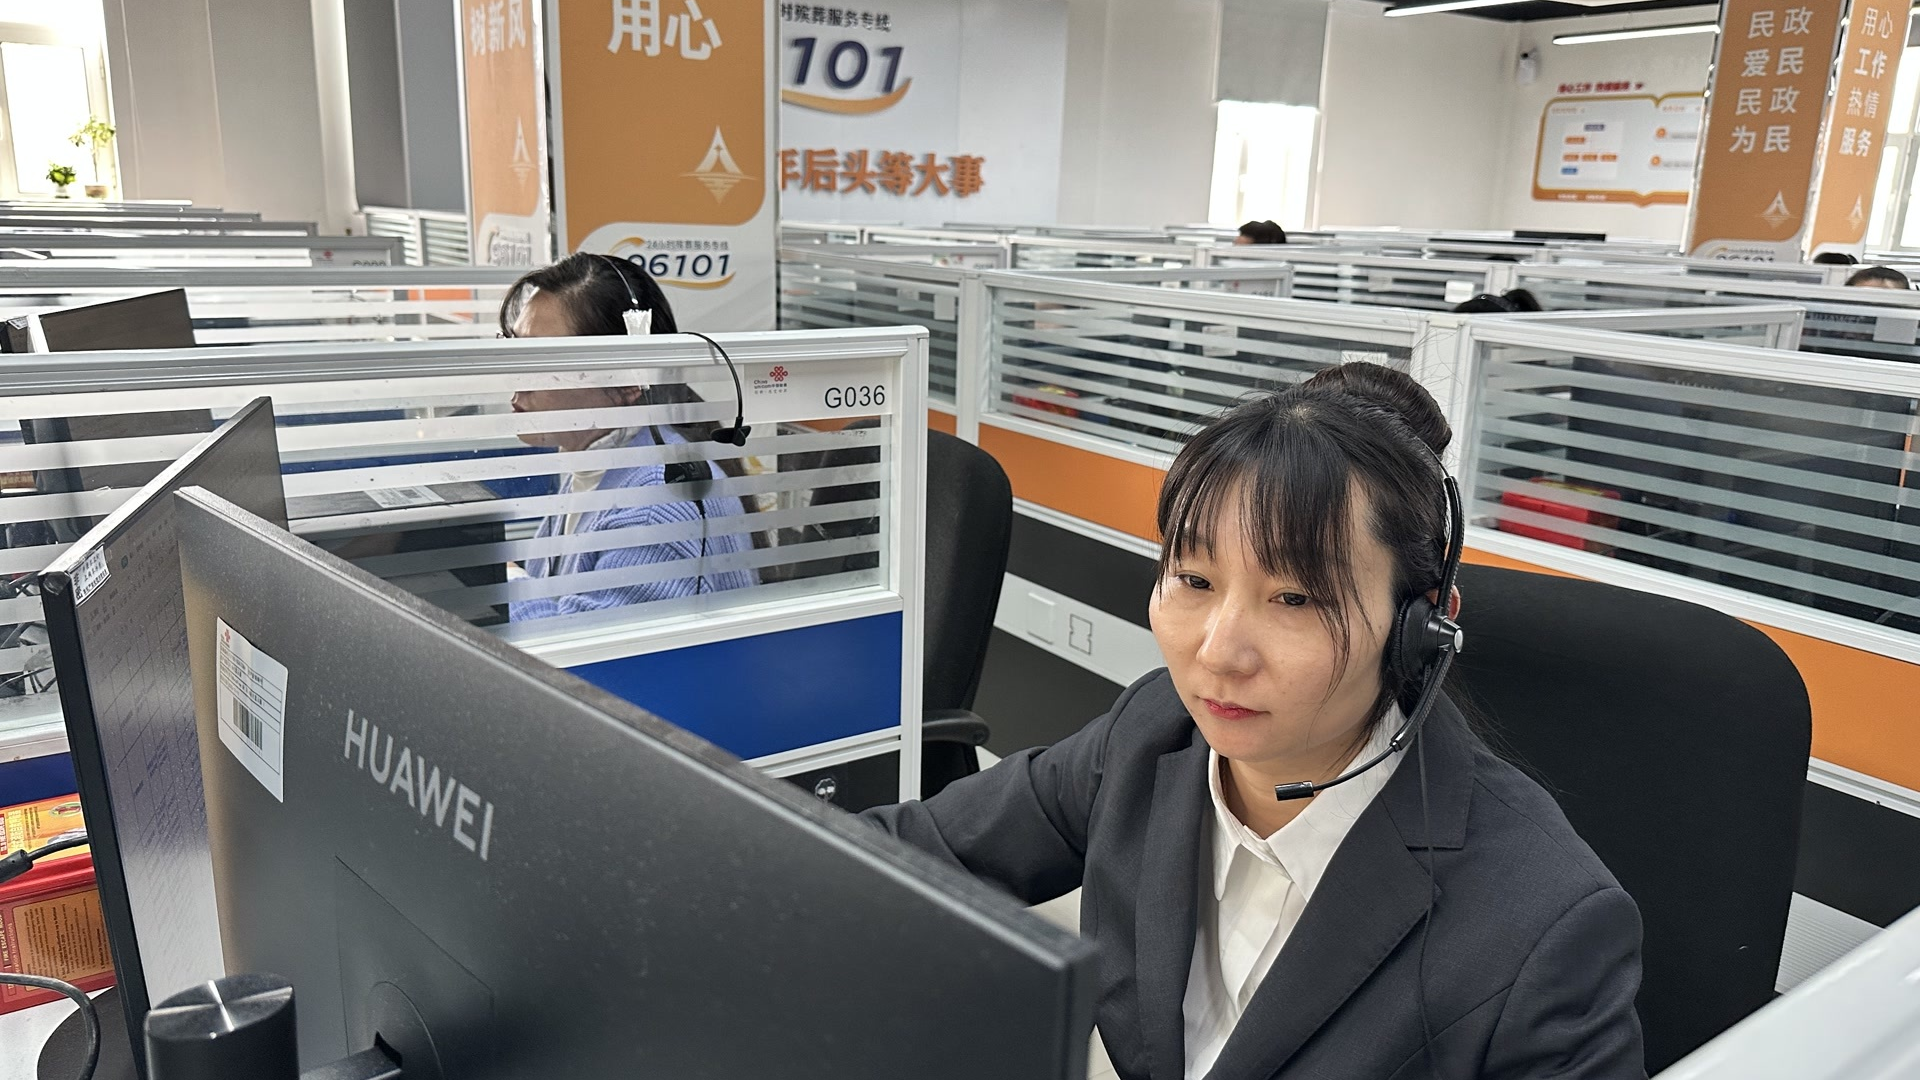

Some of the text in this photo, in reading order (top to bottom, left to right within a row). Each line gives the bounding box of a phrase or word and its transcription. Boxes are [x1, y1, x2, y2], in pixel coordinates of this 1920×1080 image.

[607, 0, 723, 60] 用心
[1748, 6, 1813, 39] 民政
[1861, 7, 1893, 39] 用心
[1741, 46, 1804, 77] 爱民
[1854, 48, 1888, 79] 工作
[1735, 85, 1800, 116] 民政
[1846, 86, 1881, 119] 热情
[1729, 124, 1791, 154] 为民
[1839, 127, 1873, 157] 服务
[824, 385, 885, 408] G036
[344, 708, 494, 861] HUAWEI
